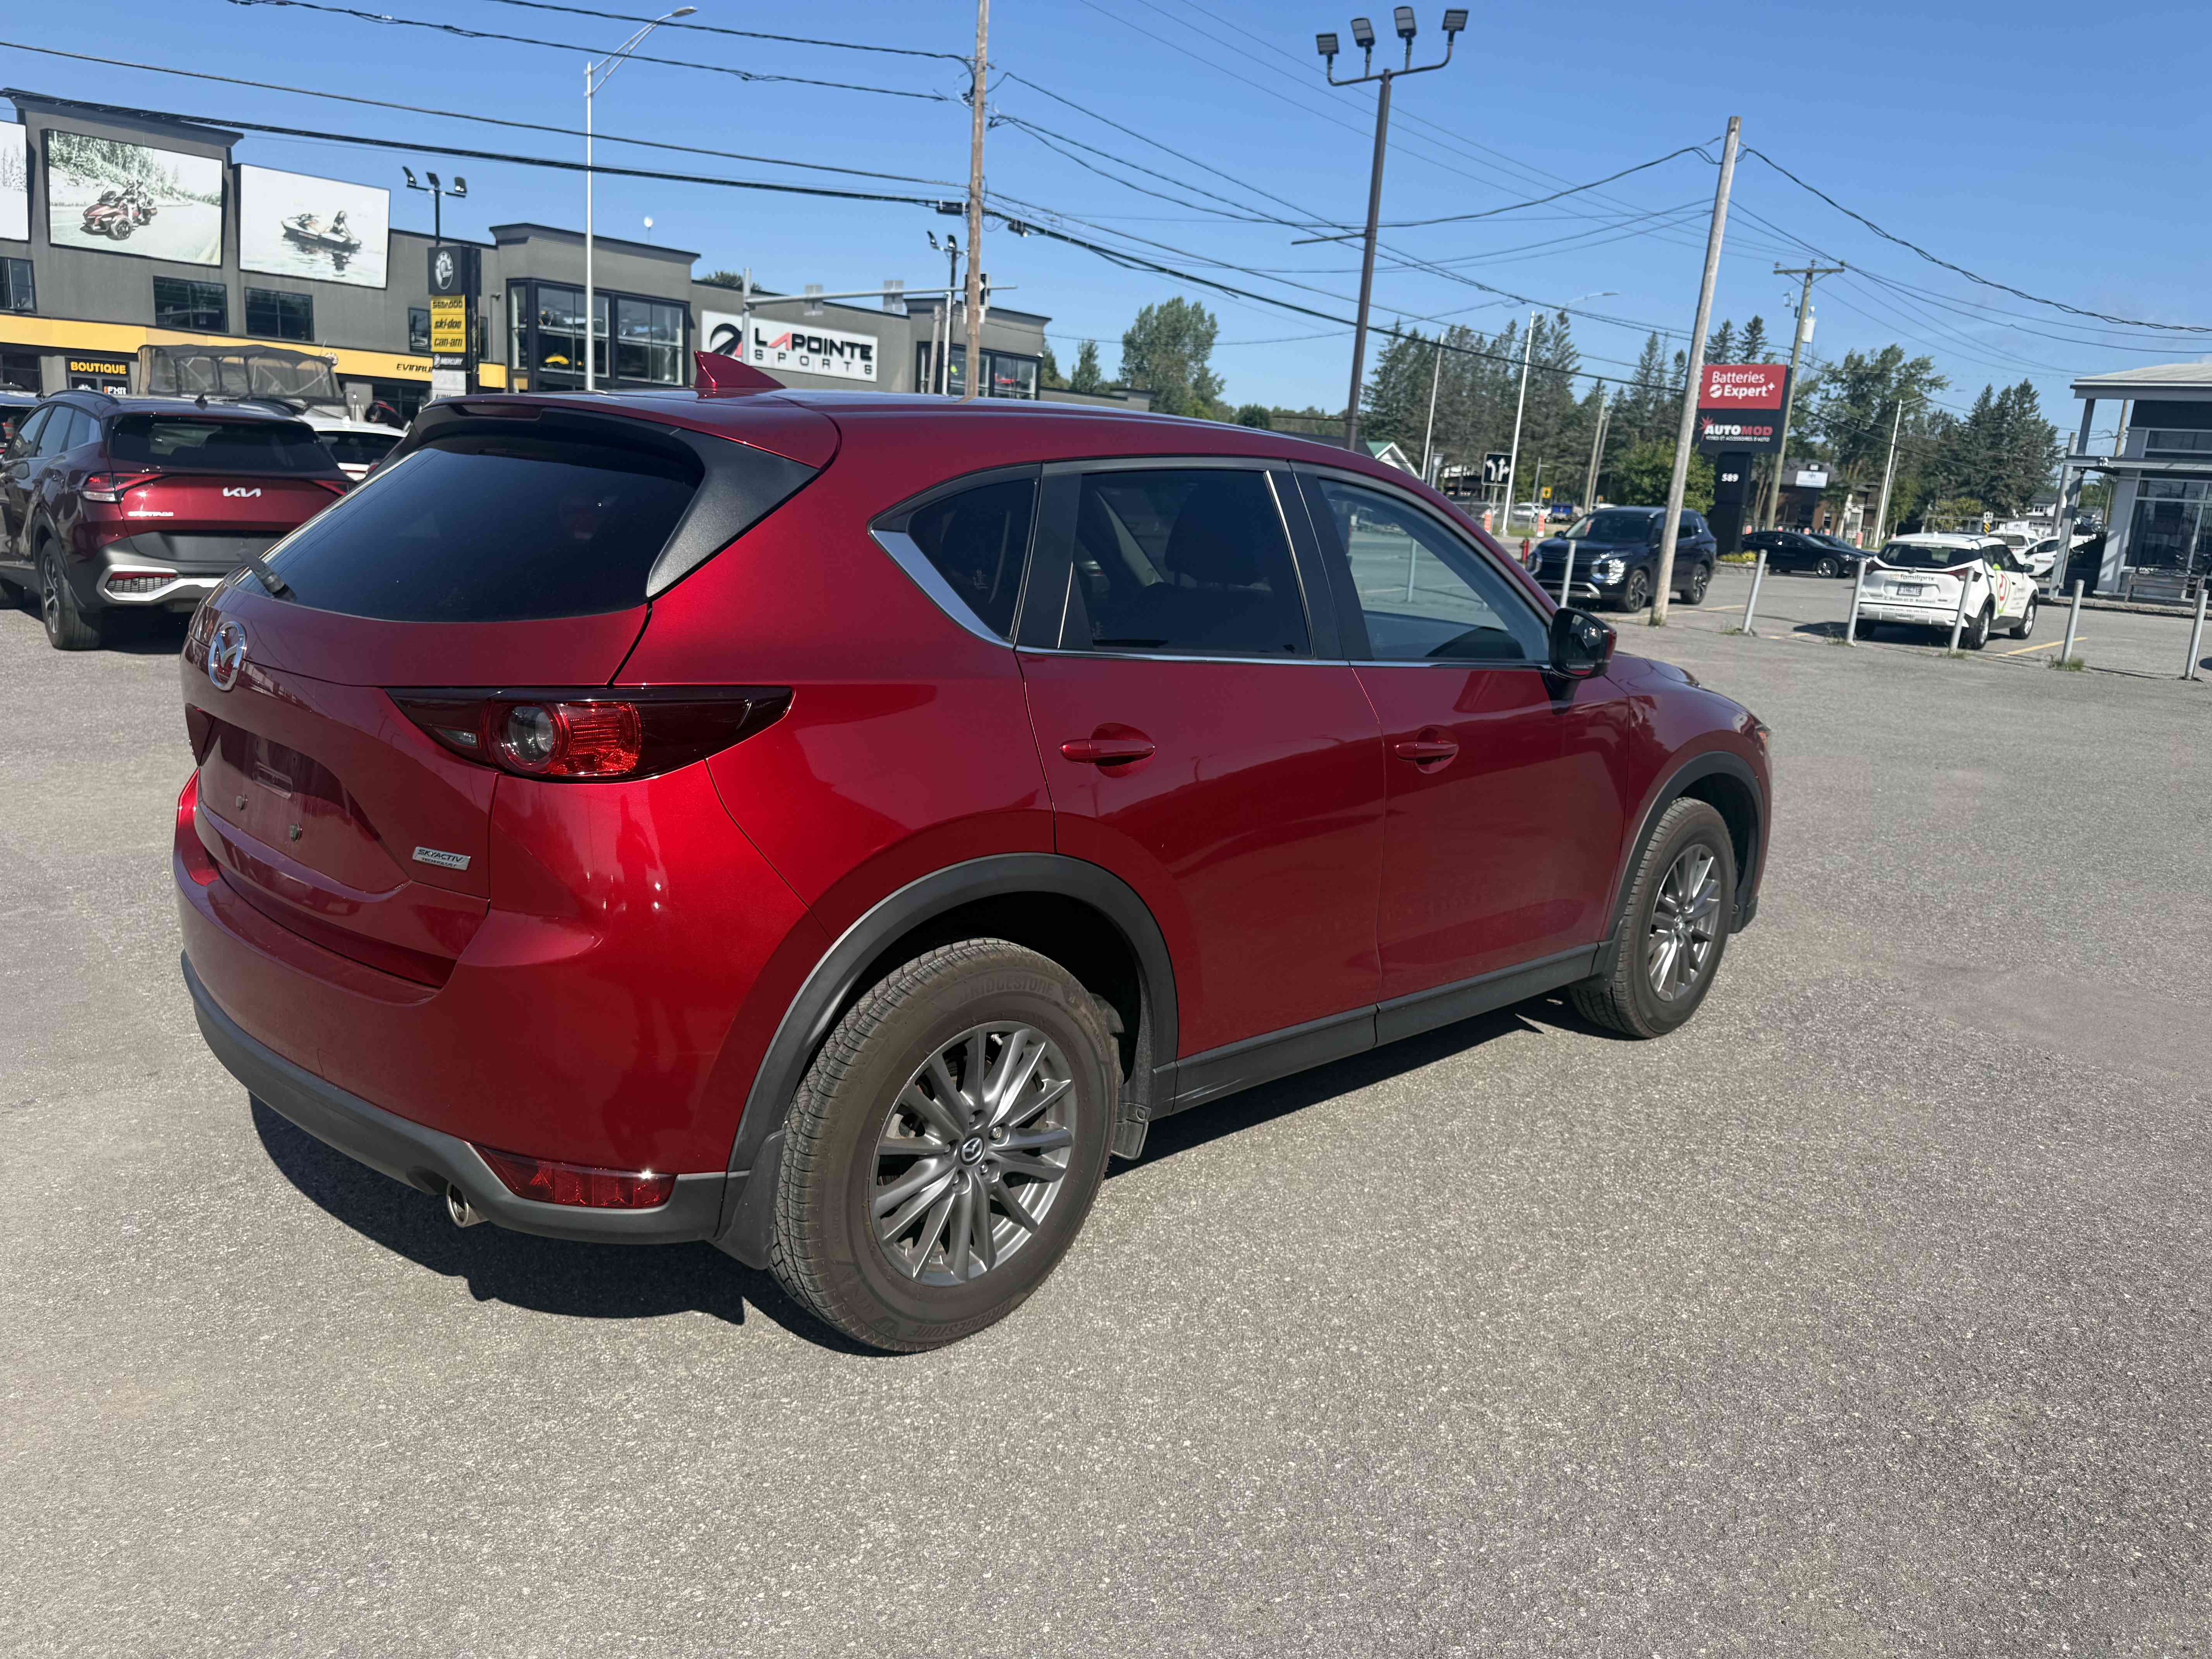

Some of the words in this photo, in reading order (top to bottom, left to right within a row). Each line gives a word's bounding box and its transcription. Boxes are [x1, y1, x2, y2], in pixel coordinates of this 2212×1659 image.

[434, 338, 463, 348] can-am
[755, 328, 872, 361] LAPOINTE
[70, 361, 127, 374] BOUTIQUE
[755, 350, 872, 374] SPORTS
[1712, 370, 1765, 383] Batteries
[1704, 424, 1773, 436] AUTOMOD
[222, 487, 262, 497] KIA
[418, 849, 463, 862] SKYACTIV
[421, 857, 457, 867] TECHNOLOGY
